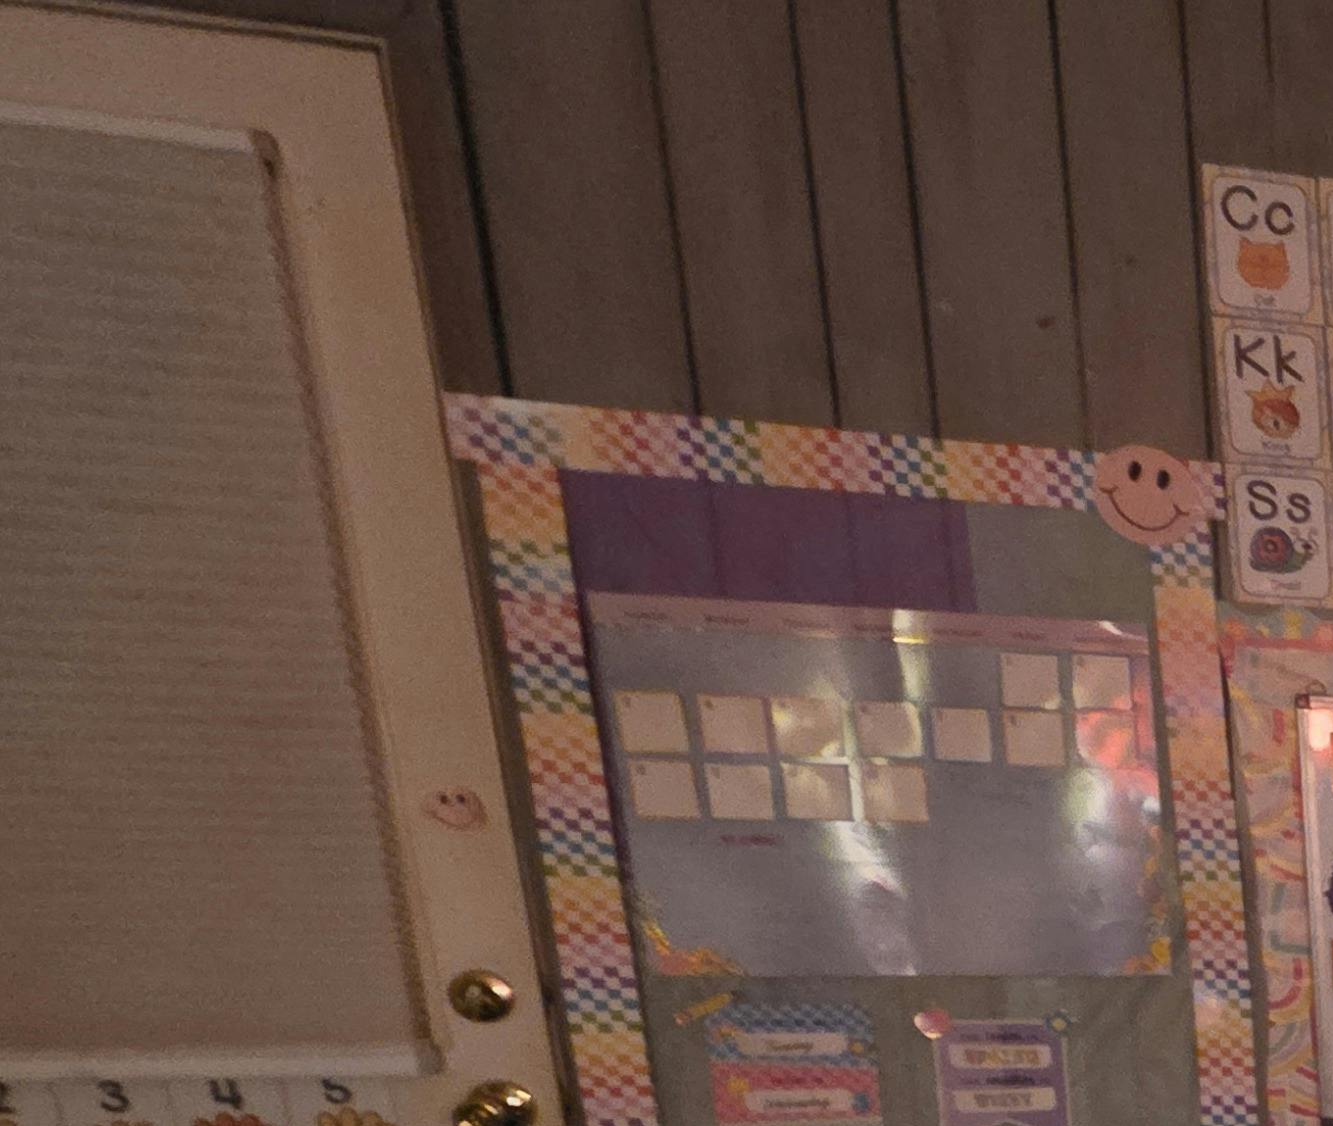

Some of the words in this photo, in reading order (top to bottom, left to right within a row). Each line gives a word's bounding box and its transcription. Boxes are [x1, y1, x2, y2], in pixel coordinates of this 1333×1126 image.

[1219, 184, 1296, 236] Cc
[1233, 333, 1304, 384] Kk
[1247, 479, 1312, 524] Ss
[99, 1079, 131, 1113] 3
[208, 1077, 244, 1110] 4
[320, 1077, 354, 1104] 5
